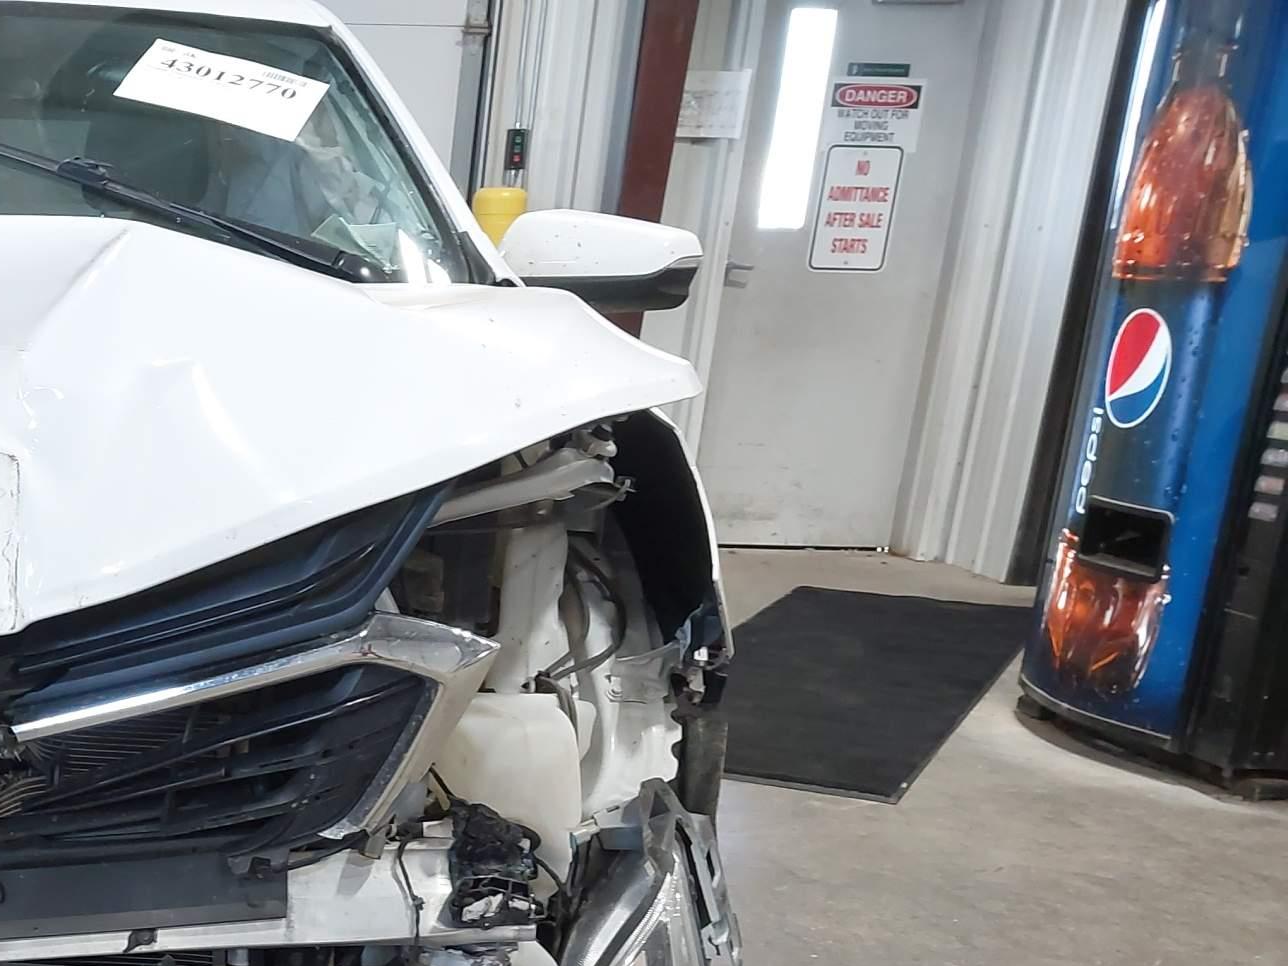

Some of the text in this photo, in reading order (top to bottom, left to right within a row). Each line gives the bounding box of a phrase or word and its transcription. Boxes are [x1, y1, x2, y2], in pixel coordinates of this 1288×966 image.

[160, 58, 297, 99] 43012770
[844, 89, 908, 103] DANGER
[871, 110, 889, 119] OUT
[891, 110, 909, 120] FOR
[844, 132, 895, 143] EQUIPMENT
[855, 160, 871, 176] NO
[828, 186, 890, 202] ADMITTANCE
[825, 212, 883, 229] AFTER SALE
[831, 238, 868, 254] STARTS
[1075, 407, 1104, 514] pepsi
